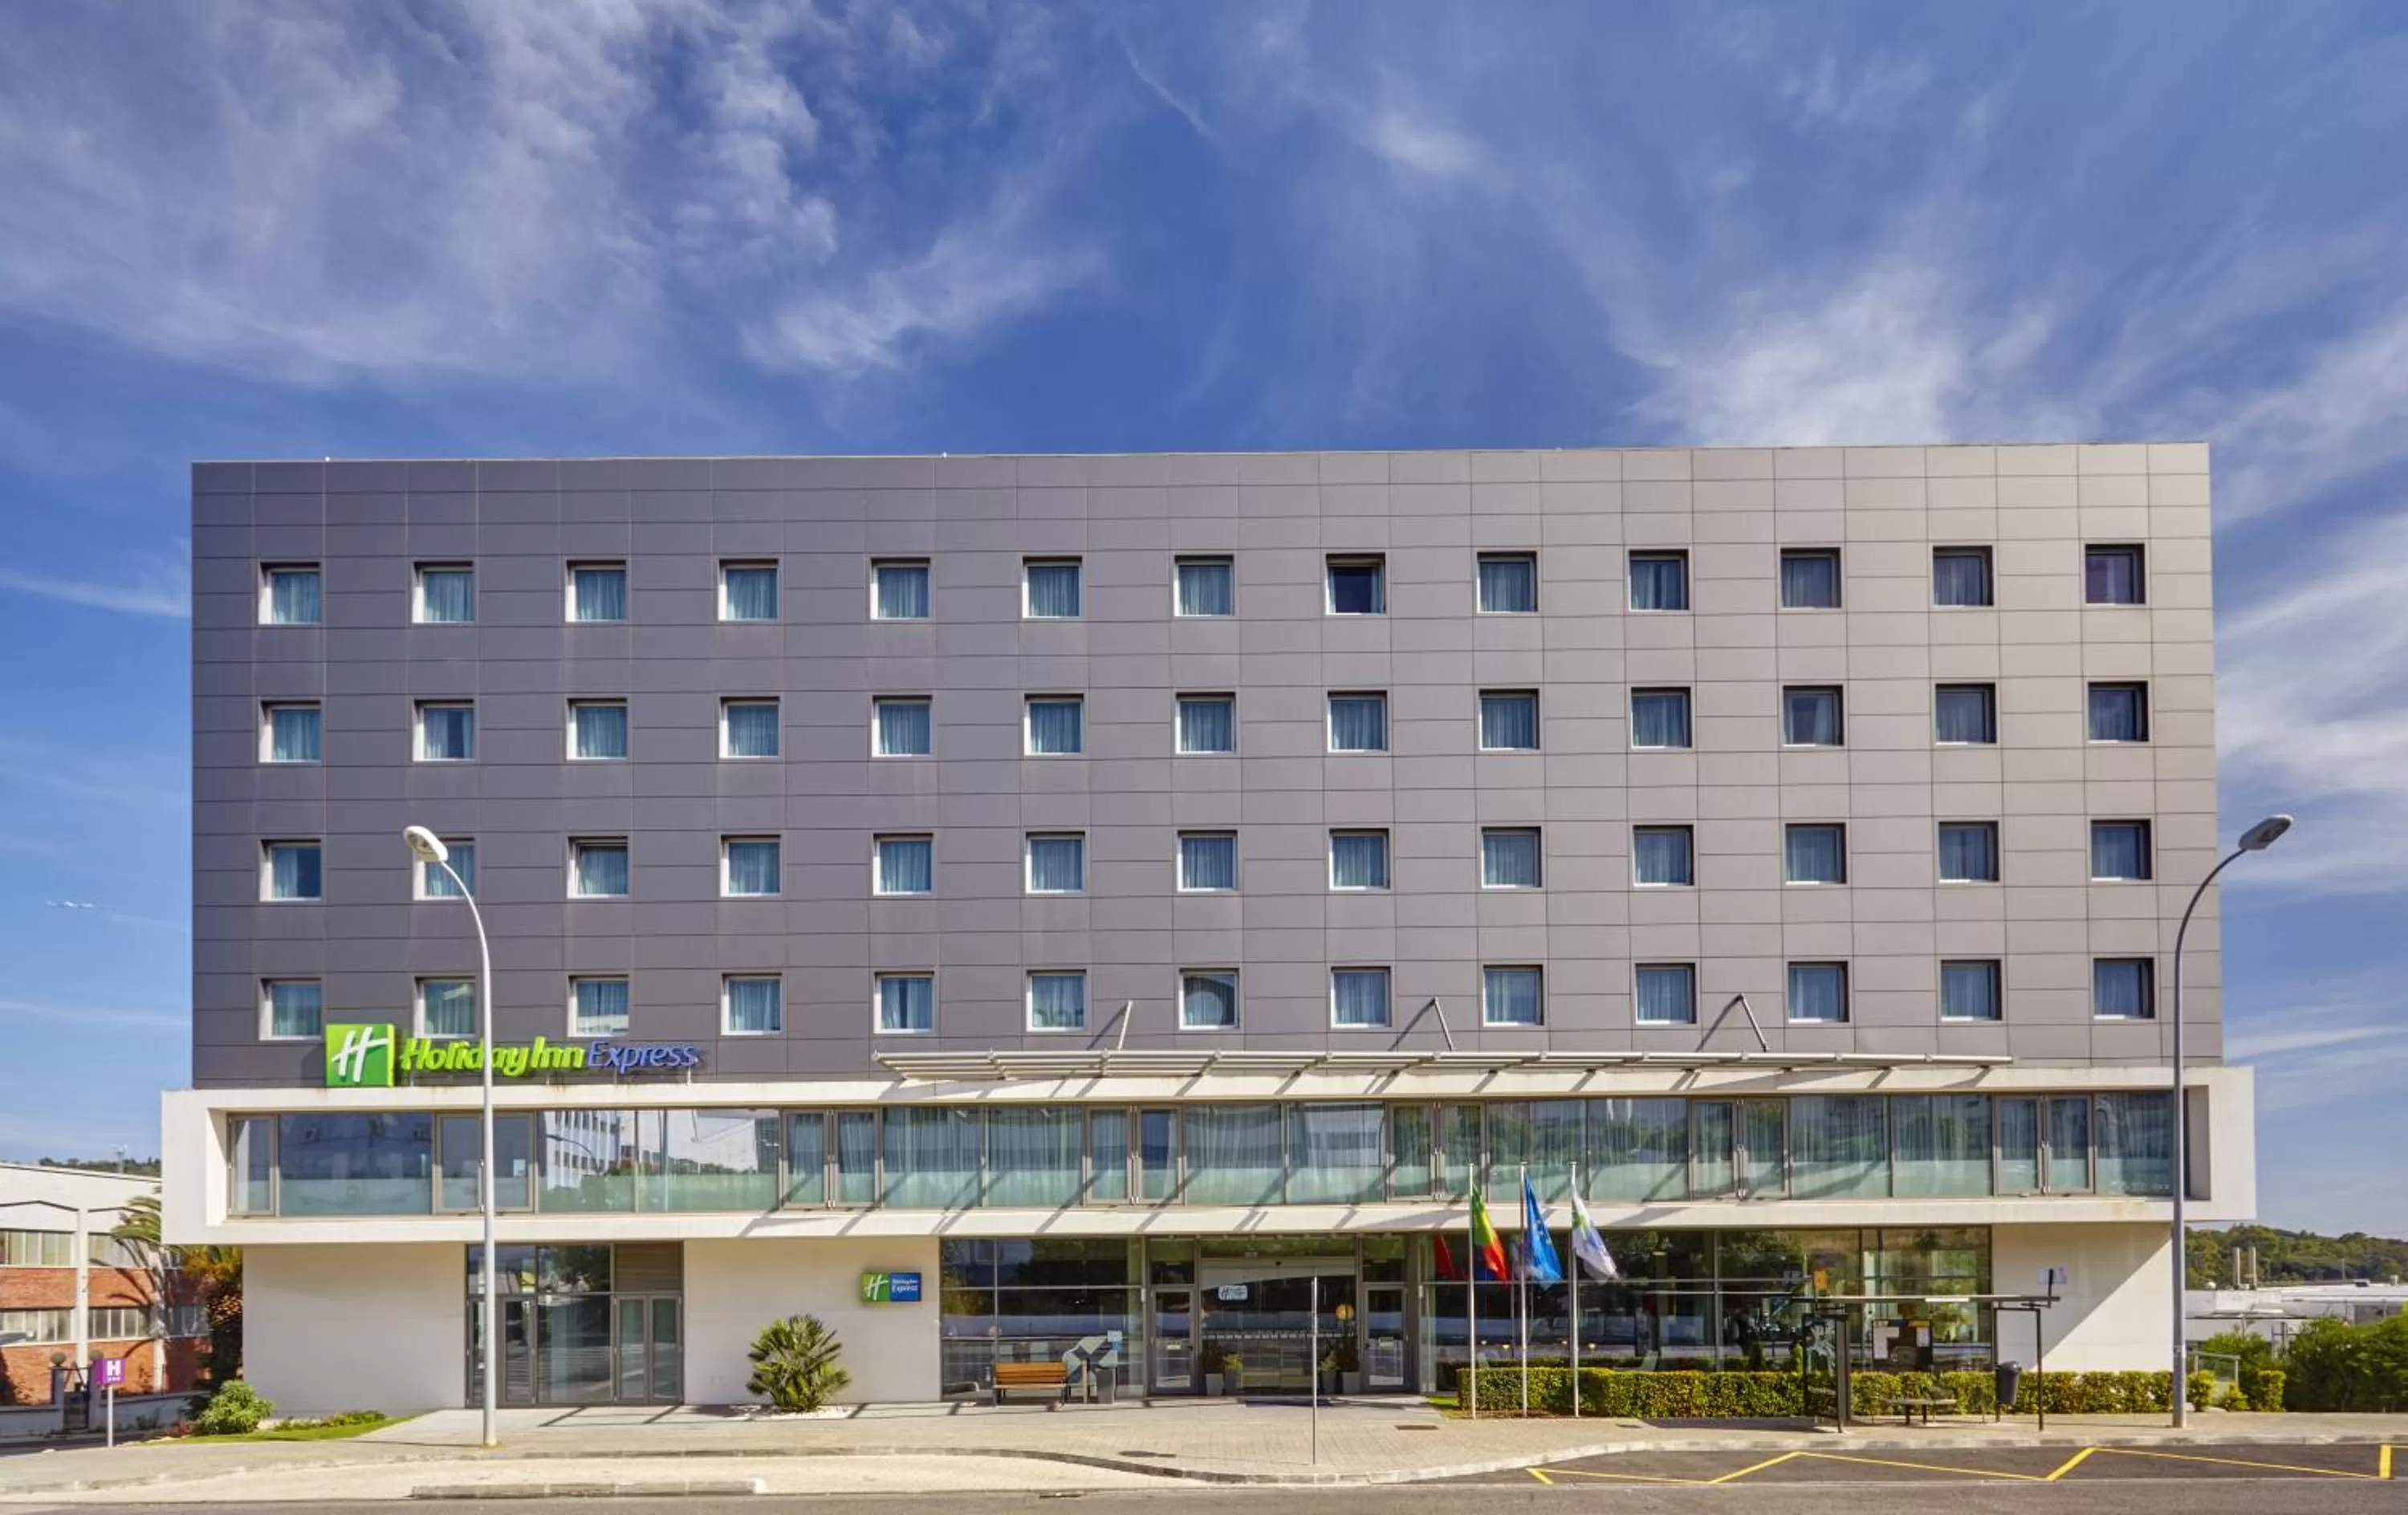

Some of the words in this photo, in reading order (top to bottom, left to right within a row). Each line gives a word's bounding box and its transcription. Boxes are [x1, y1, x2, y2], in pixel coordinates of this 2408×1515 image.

[399, 1037, 529, 1076] Holiday
[531, 1036, 586, 1068] Inn
[588, 1041, 698, 1074] Express
[107, 1360, 121, 1376] H
